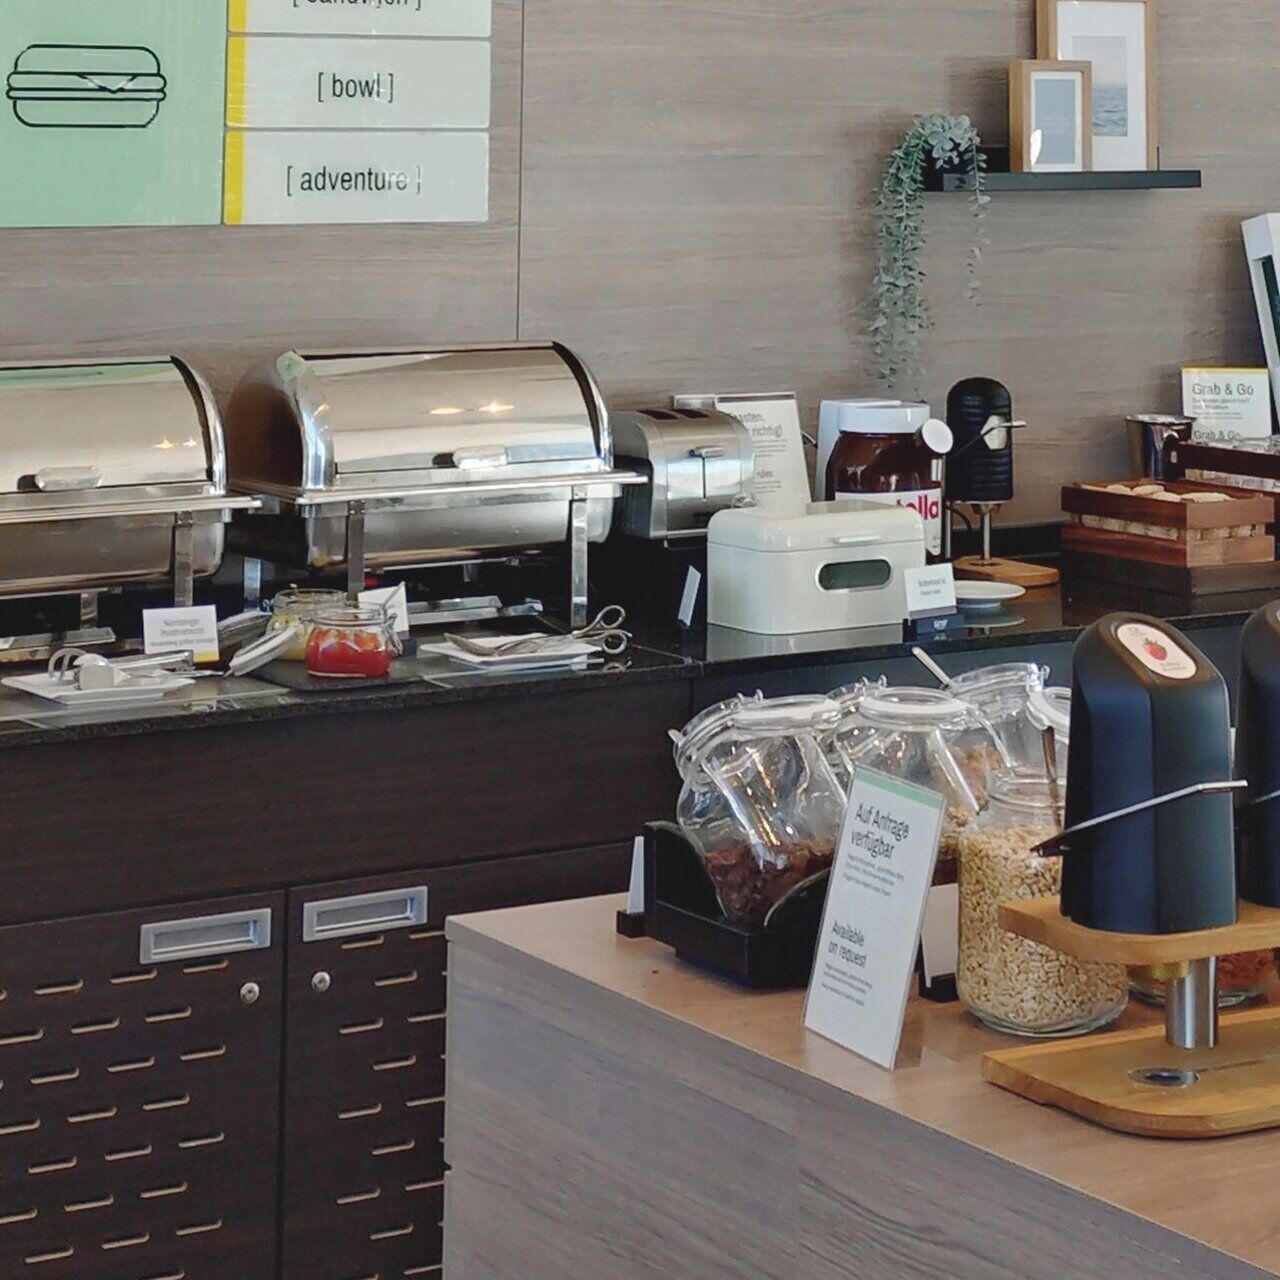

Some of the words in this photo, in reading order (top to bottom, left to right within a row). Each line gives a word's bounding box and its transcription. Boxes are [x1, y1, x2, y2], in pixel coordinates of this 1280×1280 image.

[1192, 382, 1221, 396] Grab
[1236, 383, 1254, 396] Go
[853, 802, 875, 825] Auf
[871, 809, 910, 842] Anfrage
